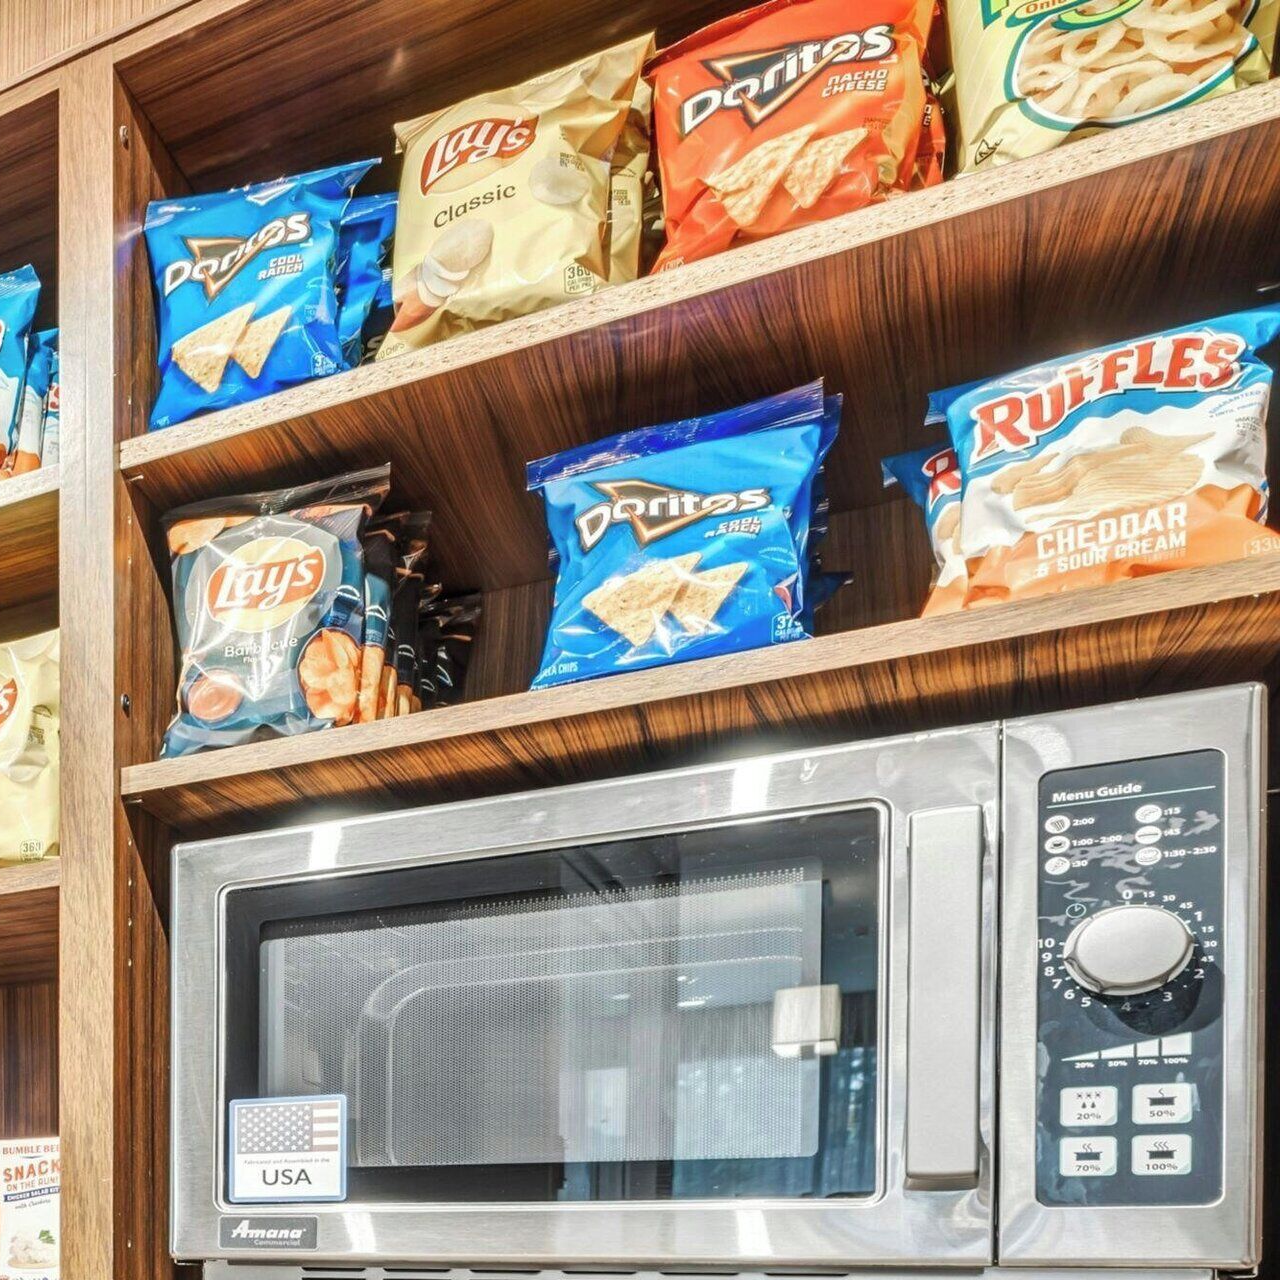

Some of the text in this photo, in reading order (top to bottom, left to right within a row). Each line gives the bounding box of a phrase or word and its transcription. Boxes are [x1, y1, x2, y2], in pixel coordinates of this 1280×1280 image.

[681, 24, 895, 136] Doritos
[827, 68, 889, 87] NACHO
[821, 79, 887, 98] CHEESE
[424, 117, 535, 189] Lay's
[433, 183, 518, 231] Classic
[269, 254, 303, 268] COOL
[257, 263, 304, 281] RANCH
[976, 332, 1241, 458] RUFFLES
[578, 488, 770, 550] Doritos
[718, 515, 762, 527] COOL
[1036, 502, 1188, 561] CHEDDAR
[1036, 530, 1187, 578] & SOUR CREAM
[214, 557, 320, 610] Lay's
[1052, 783, 1142, 803] Menu Guide
[1072, 817, 1095, 827] 2:00
[1122, 890, 1133, 900] 0
[1143, 890, 1156, 898] 15
[1163, 894, 1176, 902] 30
[1179, 901, 1194, 910] 45
[1194, 911, 1203, 921] 1
[1037, 938, 1056, 949] 10
[1203, 940, 1218, 948] 30
[1041, 952, 1053, 963] 9
[1044, 966, 1055, 977] 8
[1194, 969, 1205, 979] 2
[1052, 979, 1063, 989] 7
[1064, 989, 1076, 1000] 6
[1162, 991, 1173, 1002] 3
[1081, 997, 1092, 1008] 5
[1120, 1002, 1132, 1012] 4
[1137, 1059, 1159, 1067] 70%
[1163, 1057, 1189, 1065] 100%
[1076, 1111, 1102, 1121] 20%
[1148, 1108, 1176, 1119] 50%
[3, 1158, 61, 1183] SNACK
[1075, 1163, 1101, 1173] 70%
[1145, 1161, 1179, 1172] 100%
[262, 1168, 313, 1186] USA
[230, 1219, 303, 1239] Amana
